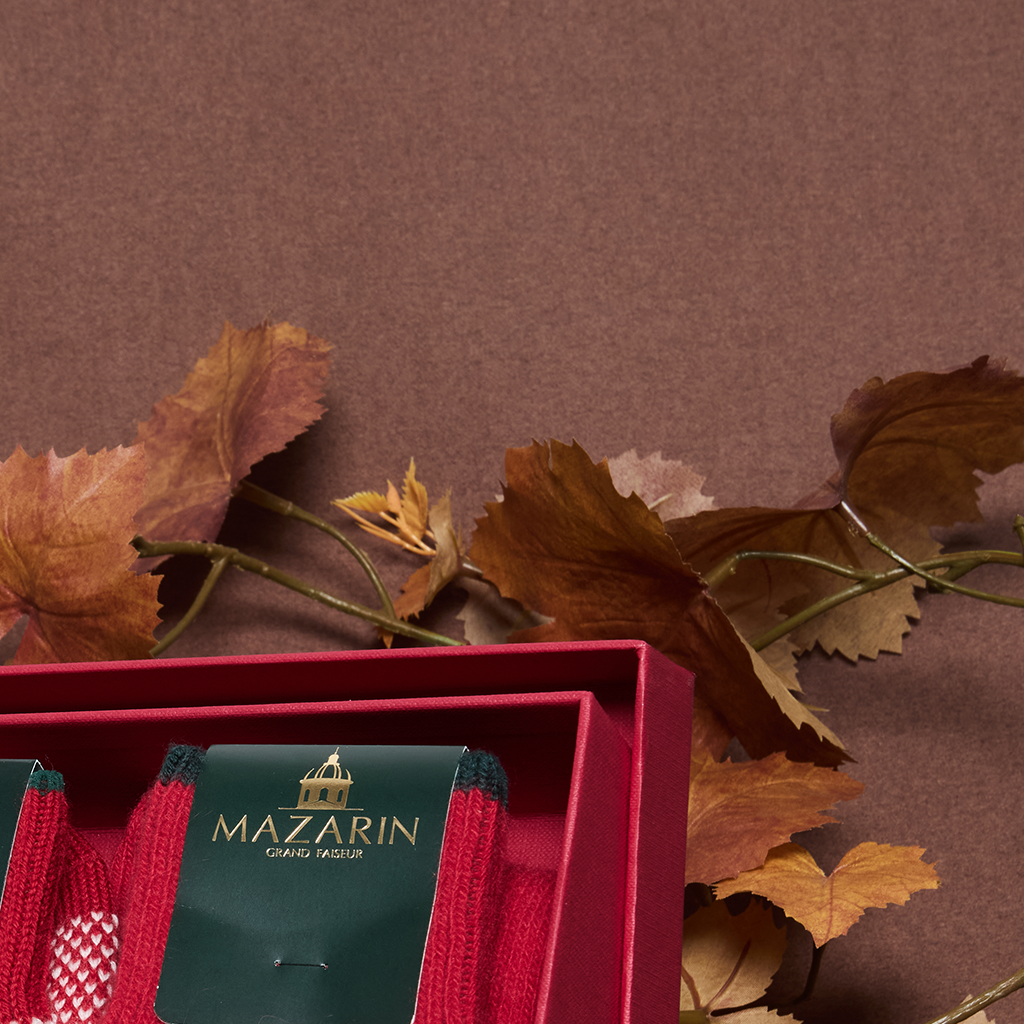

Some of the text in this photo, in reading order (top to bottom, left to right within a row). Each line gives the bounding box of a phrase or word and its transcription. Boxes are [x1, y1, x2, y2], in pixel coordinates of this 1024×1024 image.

[212, 814, 419, 845] MAZARIN
[266, 847, 364, 859] GRAND FAISEUR
